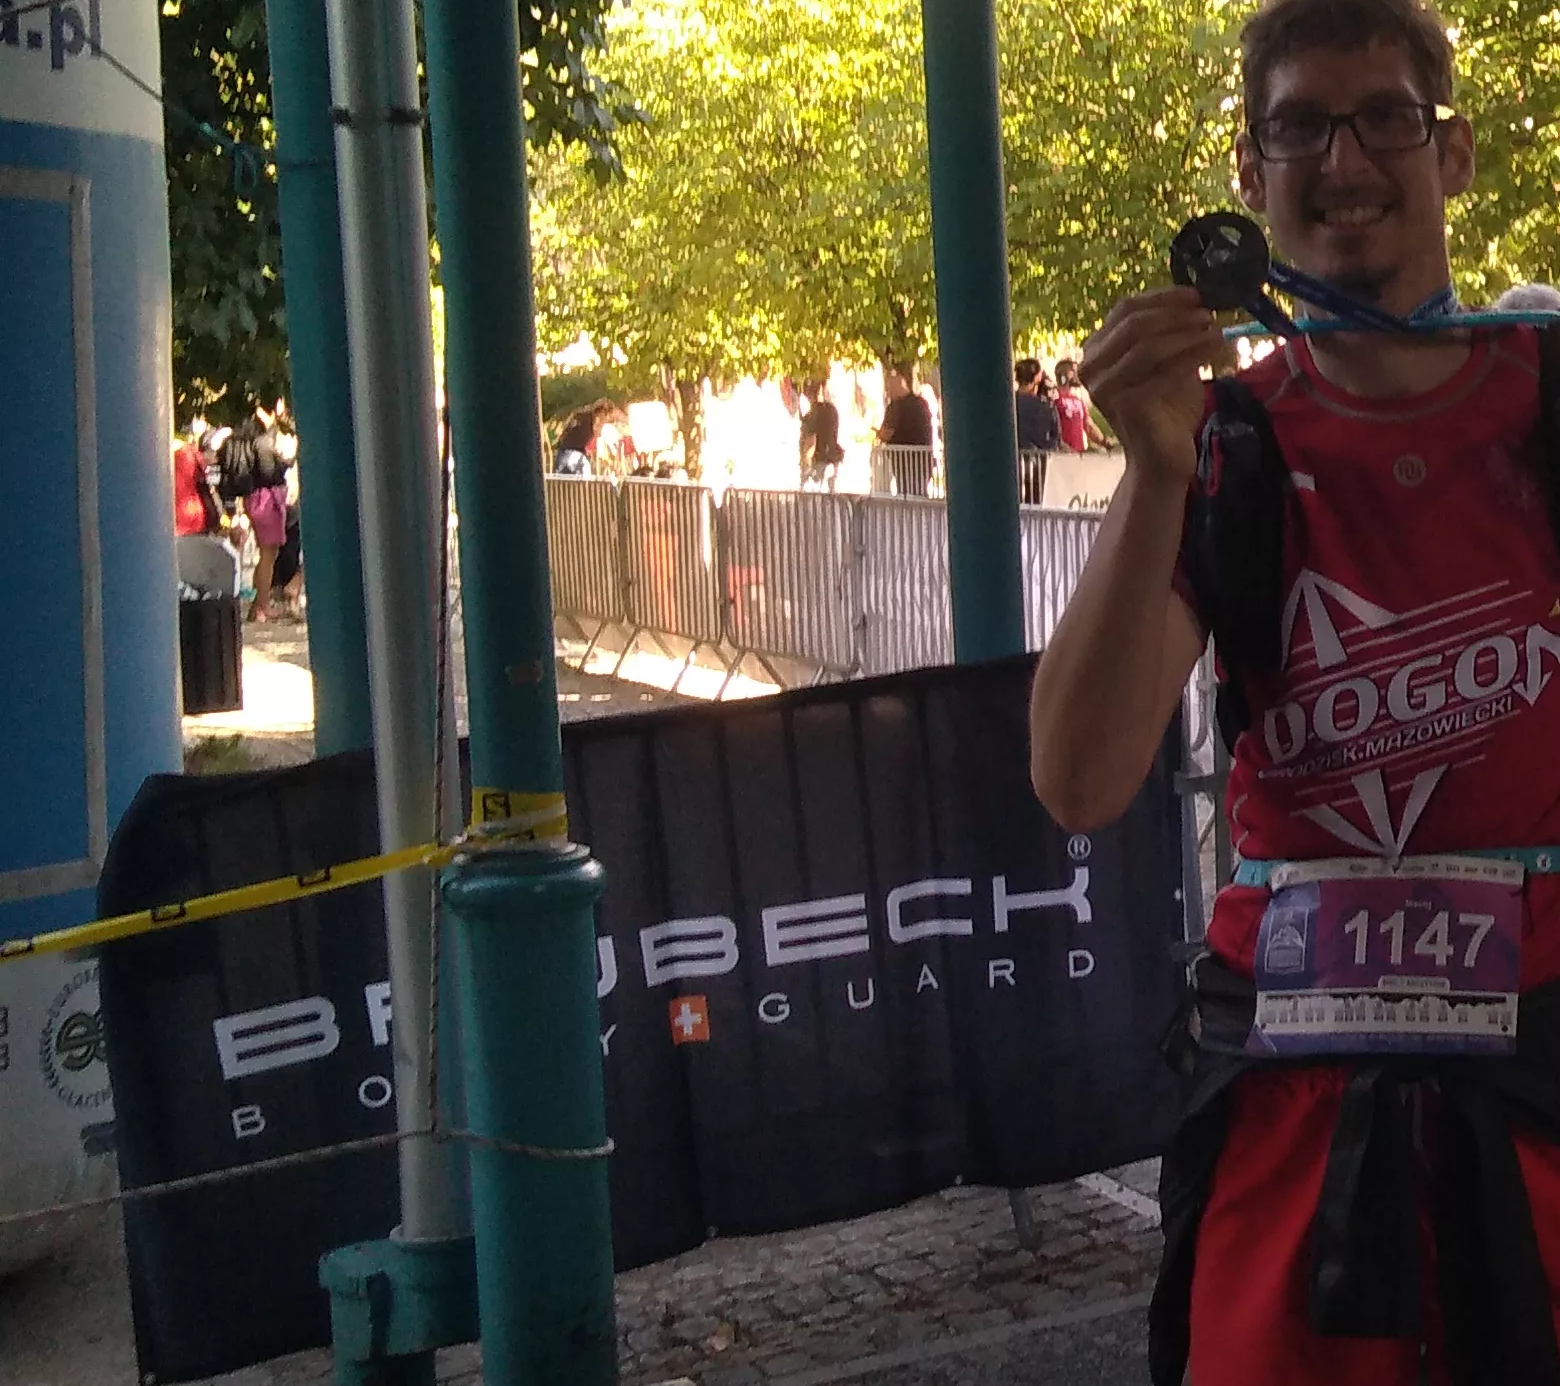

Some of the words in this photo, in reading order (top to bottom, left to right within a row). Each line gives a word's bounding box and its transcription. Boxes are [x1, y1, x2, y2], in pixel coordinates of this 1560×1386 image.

[212, 865, 1093, 1081] BBECK
[1344, 909, 1496, 968] 1147
[231, 1024, 618, 1140] BOY
[757, 949, 1096, 1025] GUARD
